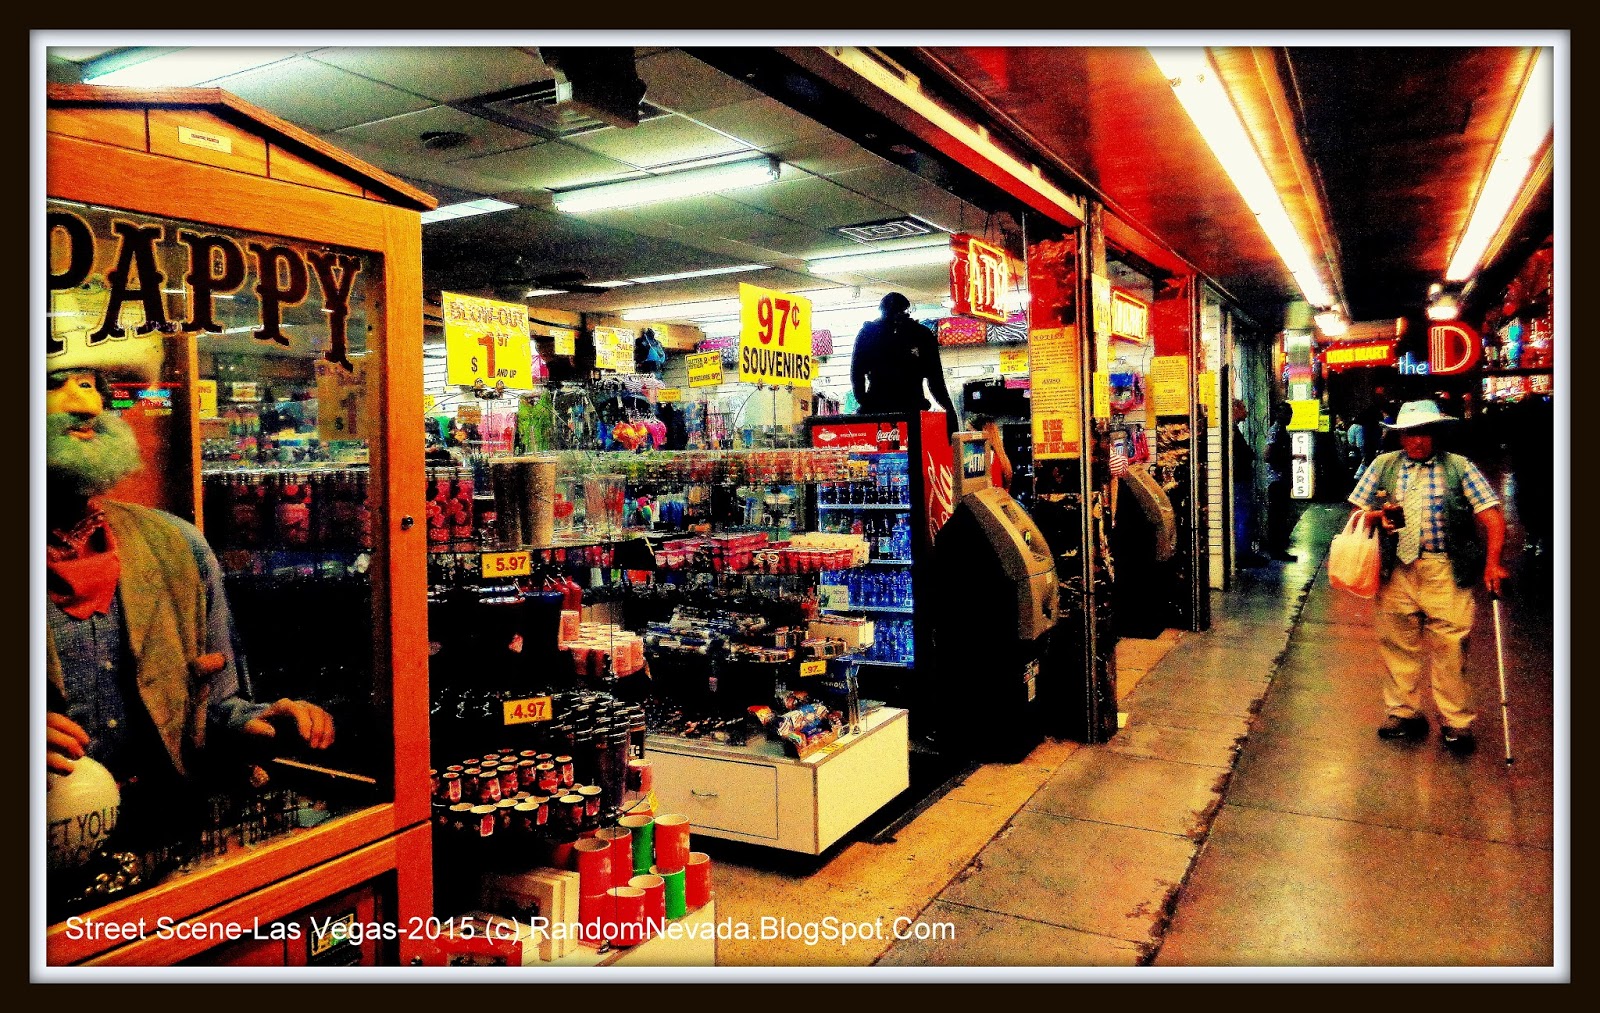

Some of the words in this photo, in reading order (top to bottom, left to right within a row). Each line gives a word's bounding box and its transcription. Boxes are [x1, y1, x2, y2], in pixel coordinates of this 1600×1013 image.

[47, 211, 361, 374] PAPPY
[968, 250, 1009, 313] ATM
[449, 301, 525, 328] BLOW-OUT
[1355, 345, 1389, 361] MART
[1397, 351, 1427, 375] the
[1431, 325, 1472, 373] D
[496, 368, 508, 377] AND
[509, 370, 517, 378] UP
[742, 345, 811, 381] SOUVENIRS
[968, 454, 985, 473] ATM
[495, 556, 527, 571] 5.97
[513, 702, 546, 719] 4.97
